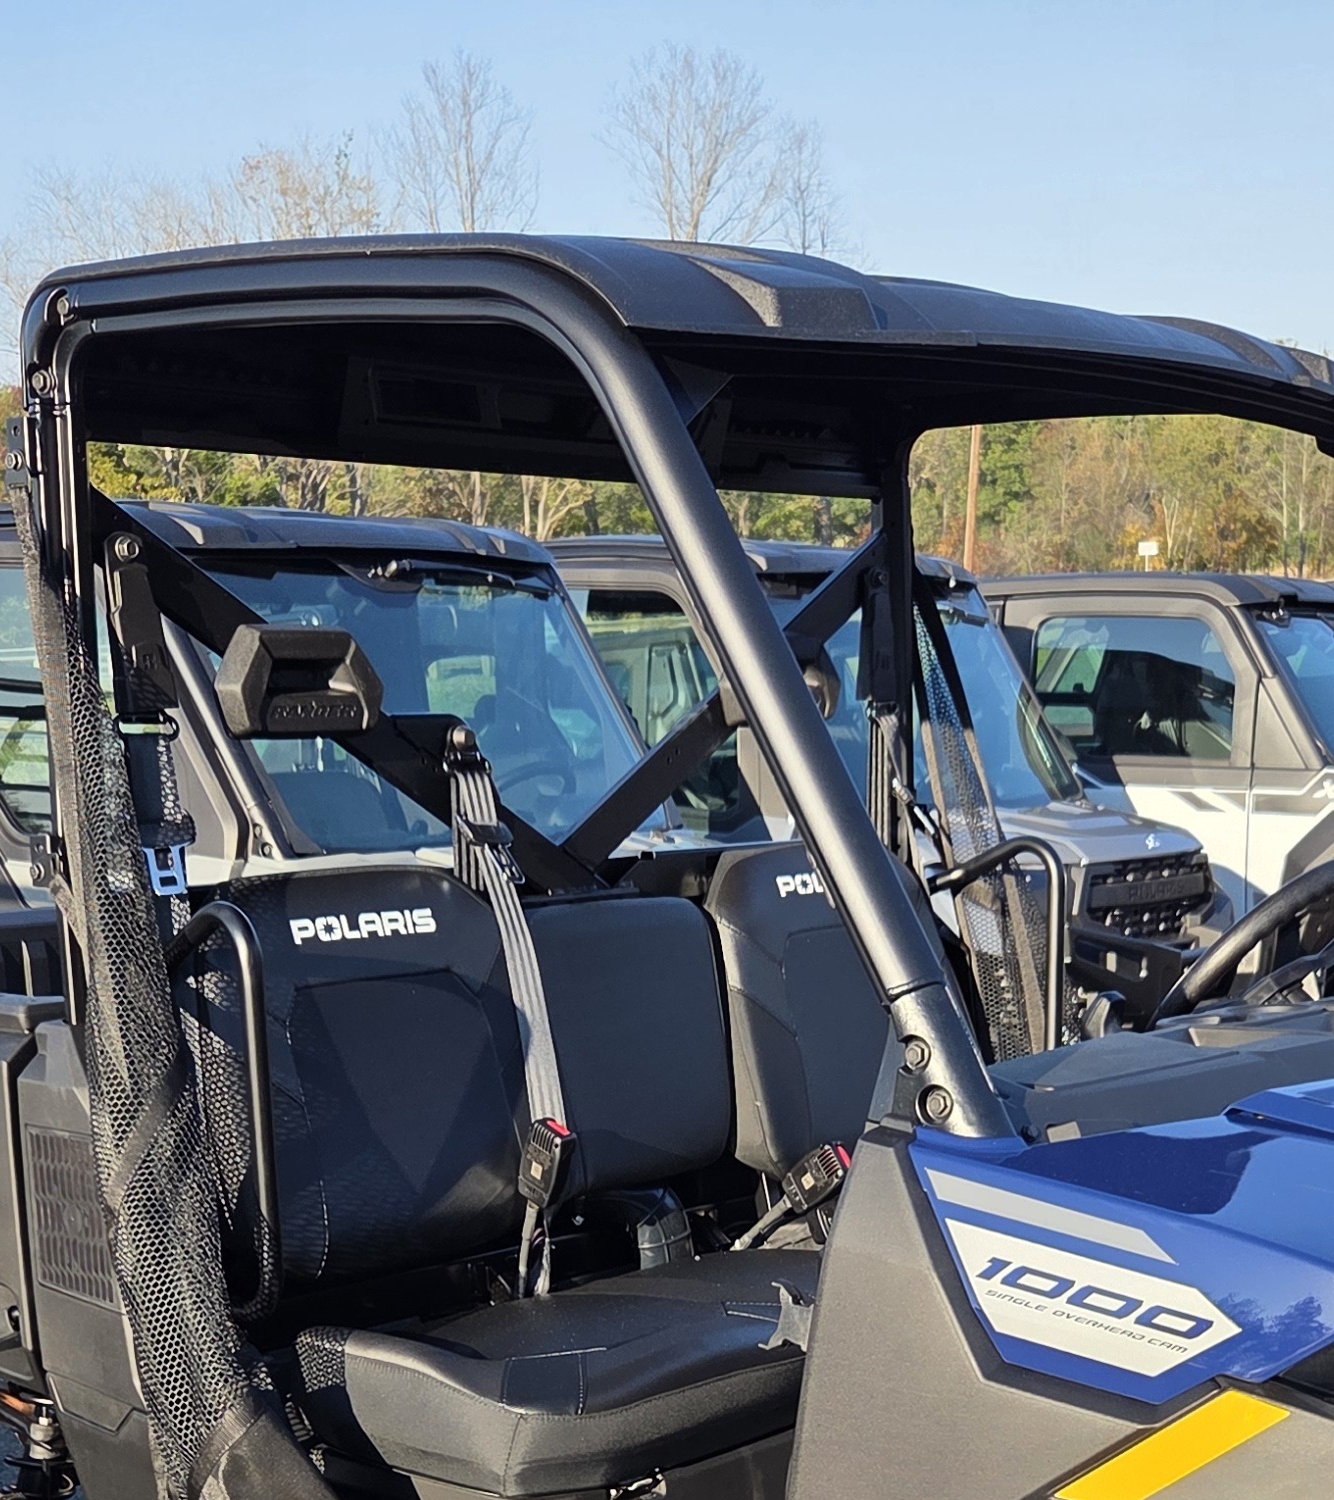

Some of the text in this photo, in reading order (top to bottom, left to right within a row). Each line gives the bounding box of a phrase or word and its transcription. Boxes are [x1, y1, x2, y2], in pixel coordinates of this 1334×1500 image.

[289, 907, 437, 945] POLARIS
[975, 1256, 1214, 1340] 1000
[985, 1289, 1188, 1354] SINGLE OVERHEAD CAM
